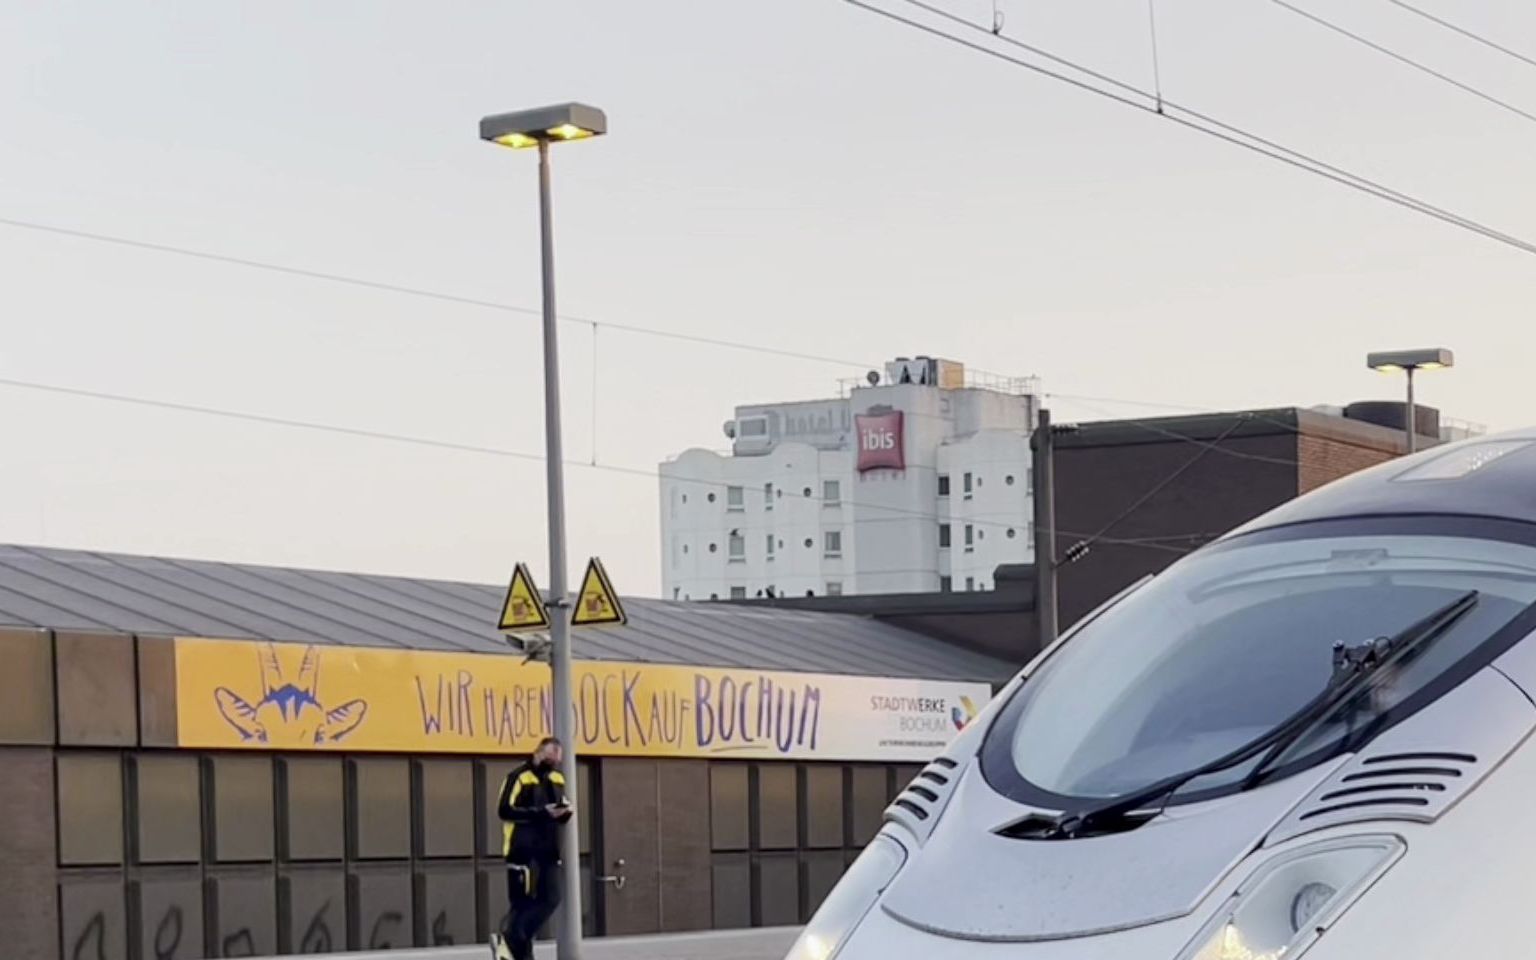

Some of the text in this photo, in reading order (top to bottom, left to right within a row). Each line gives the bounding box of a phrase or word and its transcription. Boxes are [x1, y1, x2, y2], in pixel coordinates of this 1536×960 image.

[862, 428, 895, 450] ibis
[415, 669, 473, 737] WIR
[483, 684, 552, 746] HABEN
[649, 690, 692, 748] AUF
[694, 672, 821, 752] BOCHUM
[870, 696, 945, 713] STADTWERKE
[900, 716, 946, 732] BOCHUM
